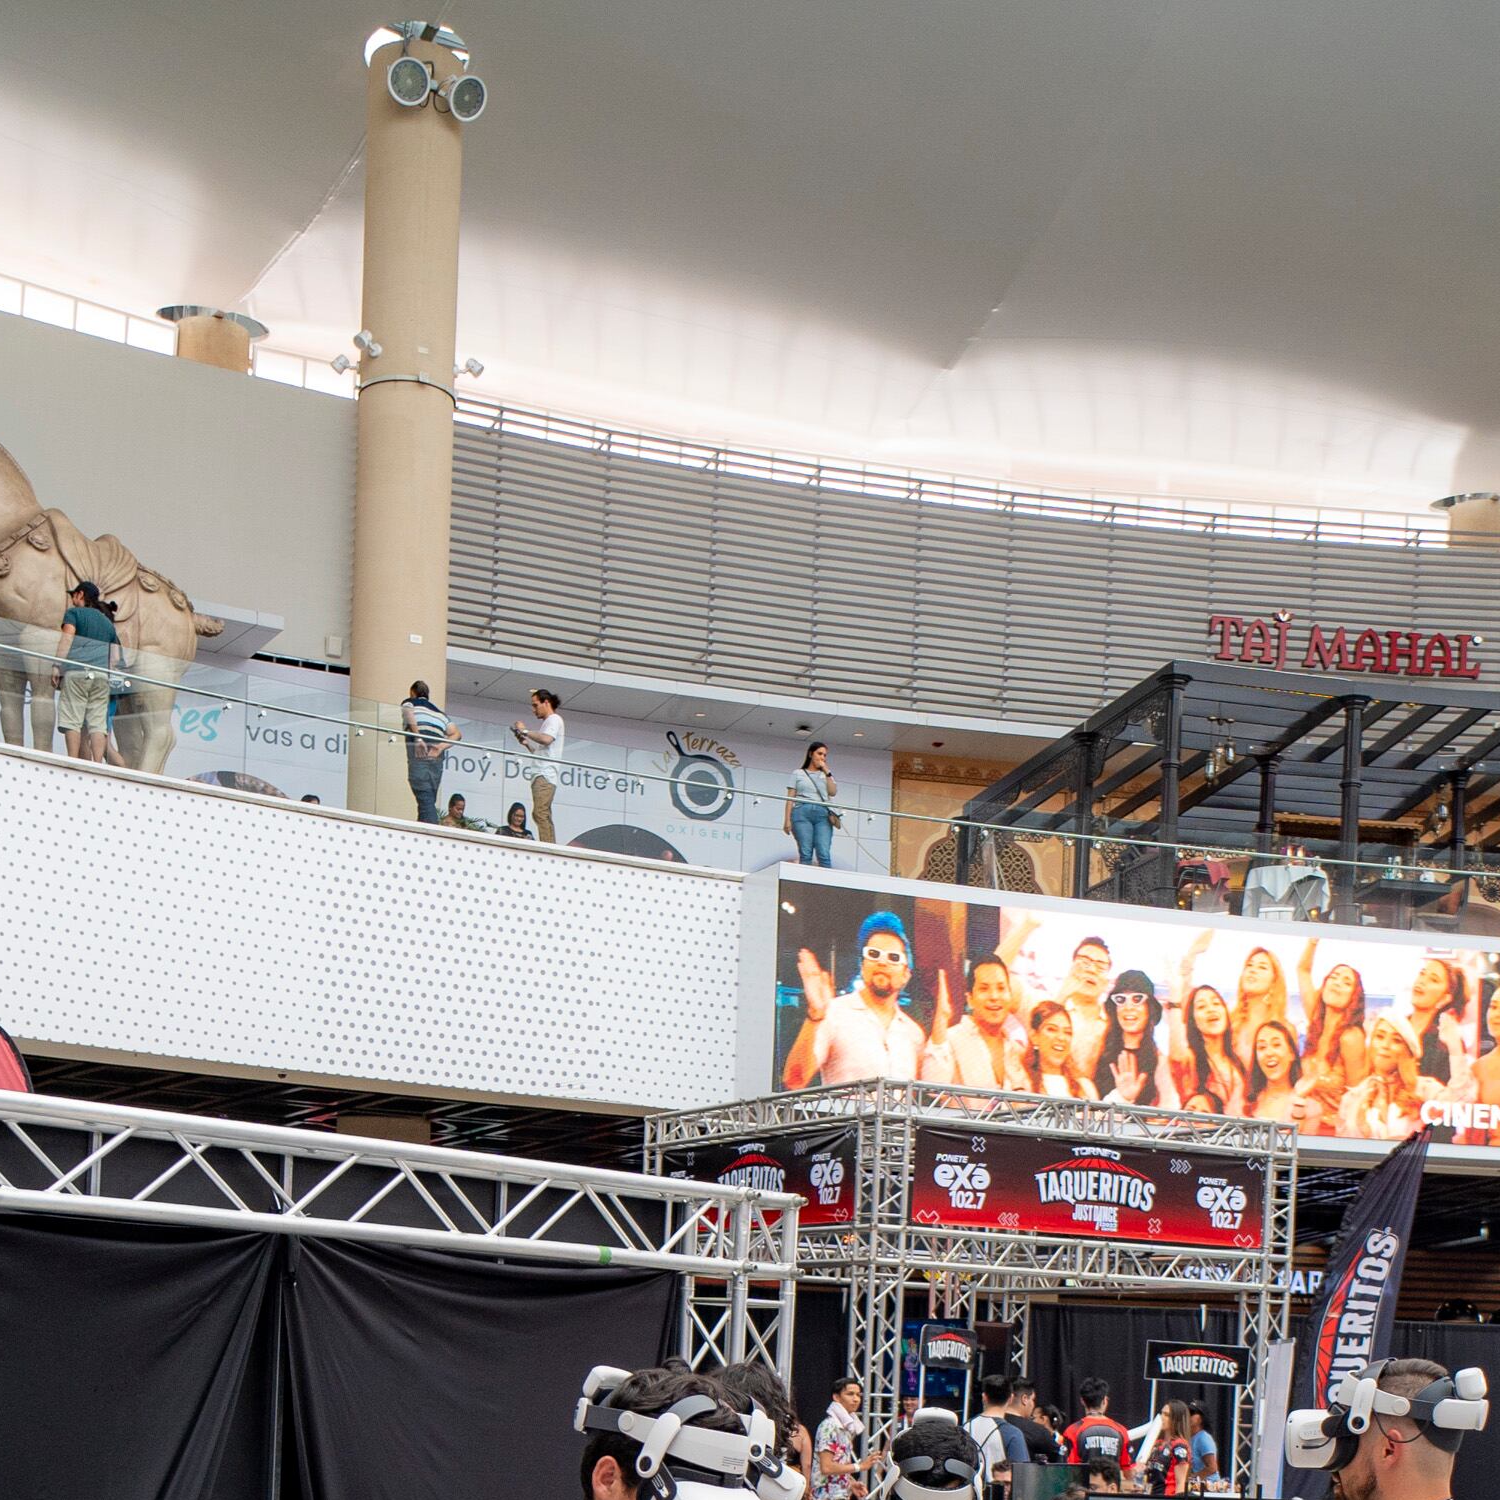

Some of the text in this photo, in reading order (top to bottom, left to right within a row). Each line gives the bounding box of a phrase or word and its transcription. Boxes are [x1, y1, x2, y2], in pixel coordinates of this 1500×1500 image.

[1209, 612, 1482, 680] TAJ MAHAL
[245, 724, 293, 748] vas
[300, 733, 316, 751] a
[935, 1152, 969, 1165] PONETE
[1034, 1169, 1156, 1213] TAQUERITOS
[1197, 1176, 1228, 1187] PONETE
[817, 1186, 841, 1205] 102.7
[948, 1189, 986, 1210] 102.7
[1209, 1210, 1242, 1230] 102.7
[1326, 1230, 1399, 1404] UERITOS
[926, 1340, 972, 1364] TAQUERITOS
[1157, 1355, 1240, 1379] TAQUERITOS
